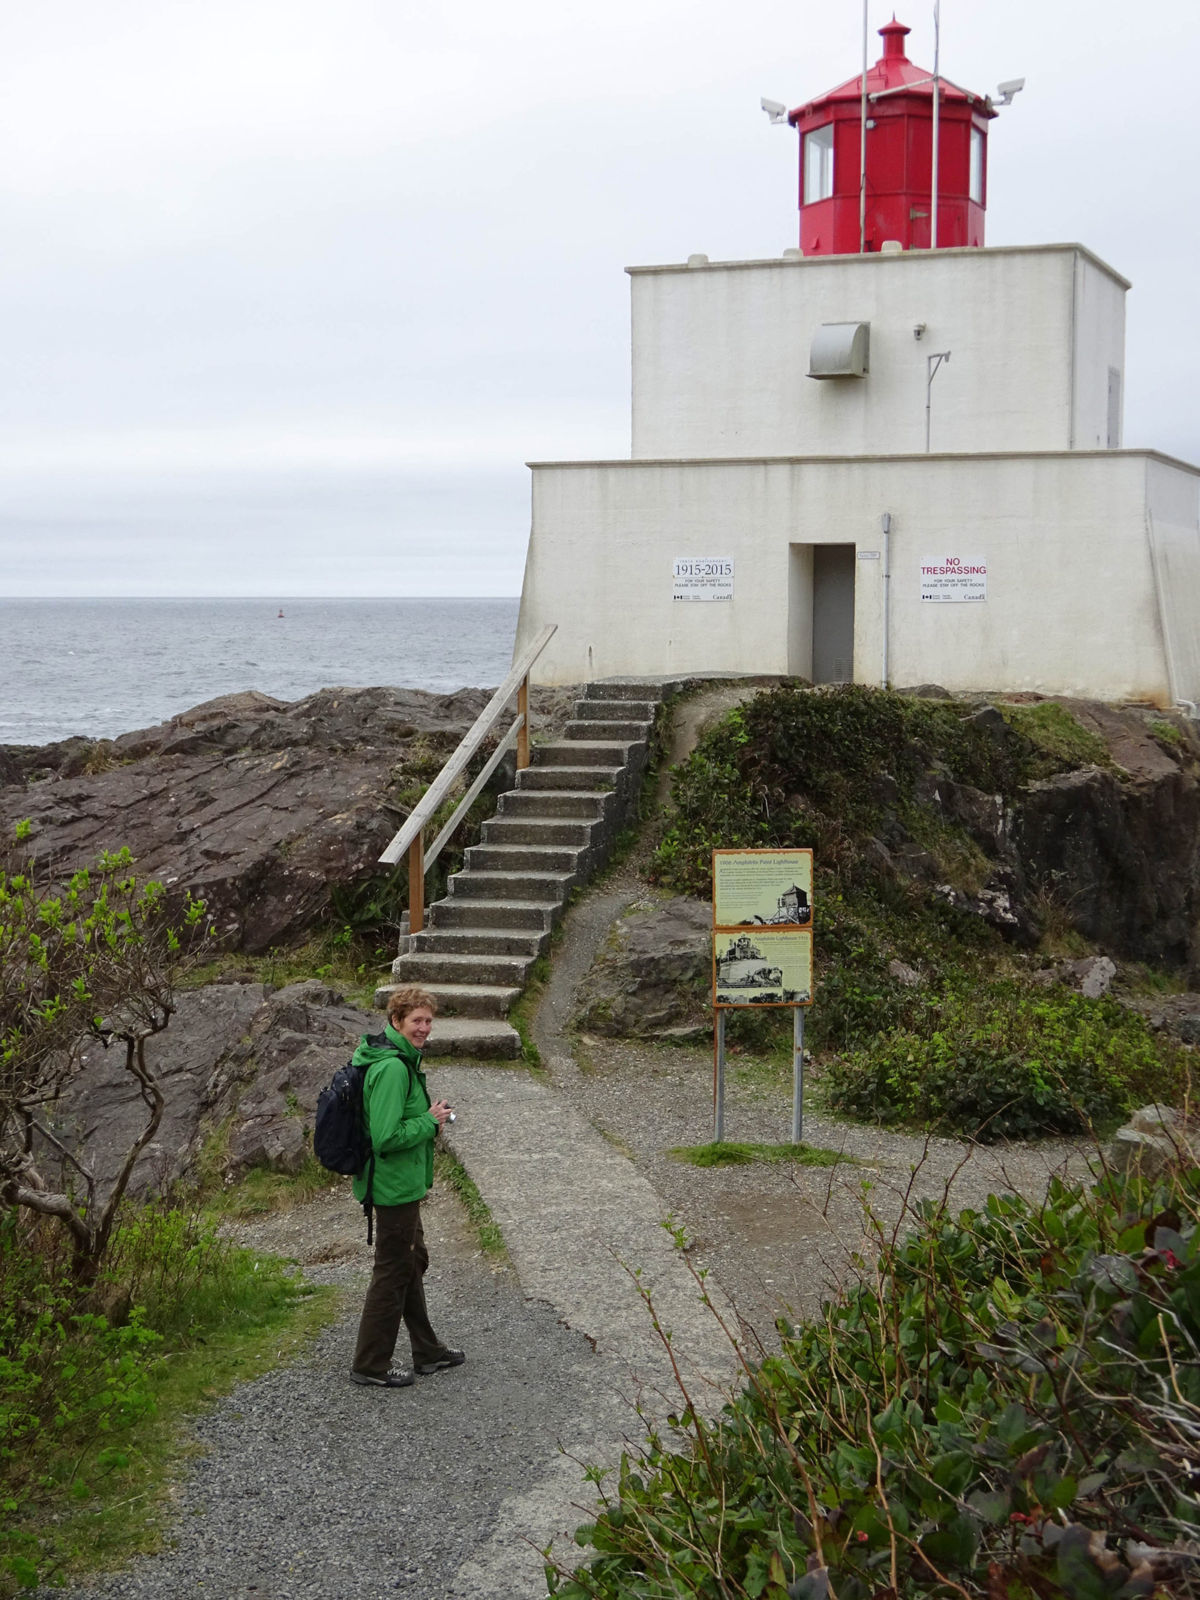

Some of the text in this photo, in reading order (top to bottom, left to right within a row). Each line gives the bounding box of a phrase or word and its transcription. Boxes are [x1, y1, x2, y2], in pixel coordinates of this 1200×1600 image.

[946, 558, 960, 566] NO
[675, 564, 732, 576] 1915-2015
[921, 566, 986, 574] TRESPASSING
